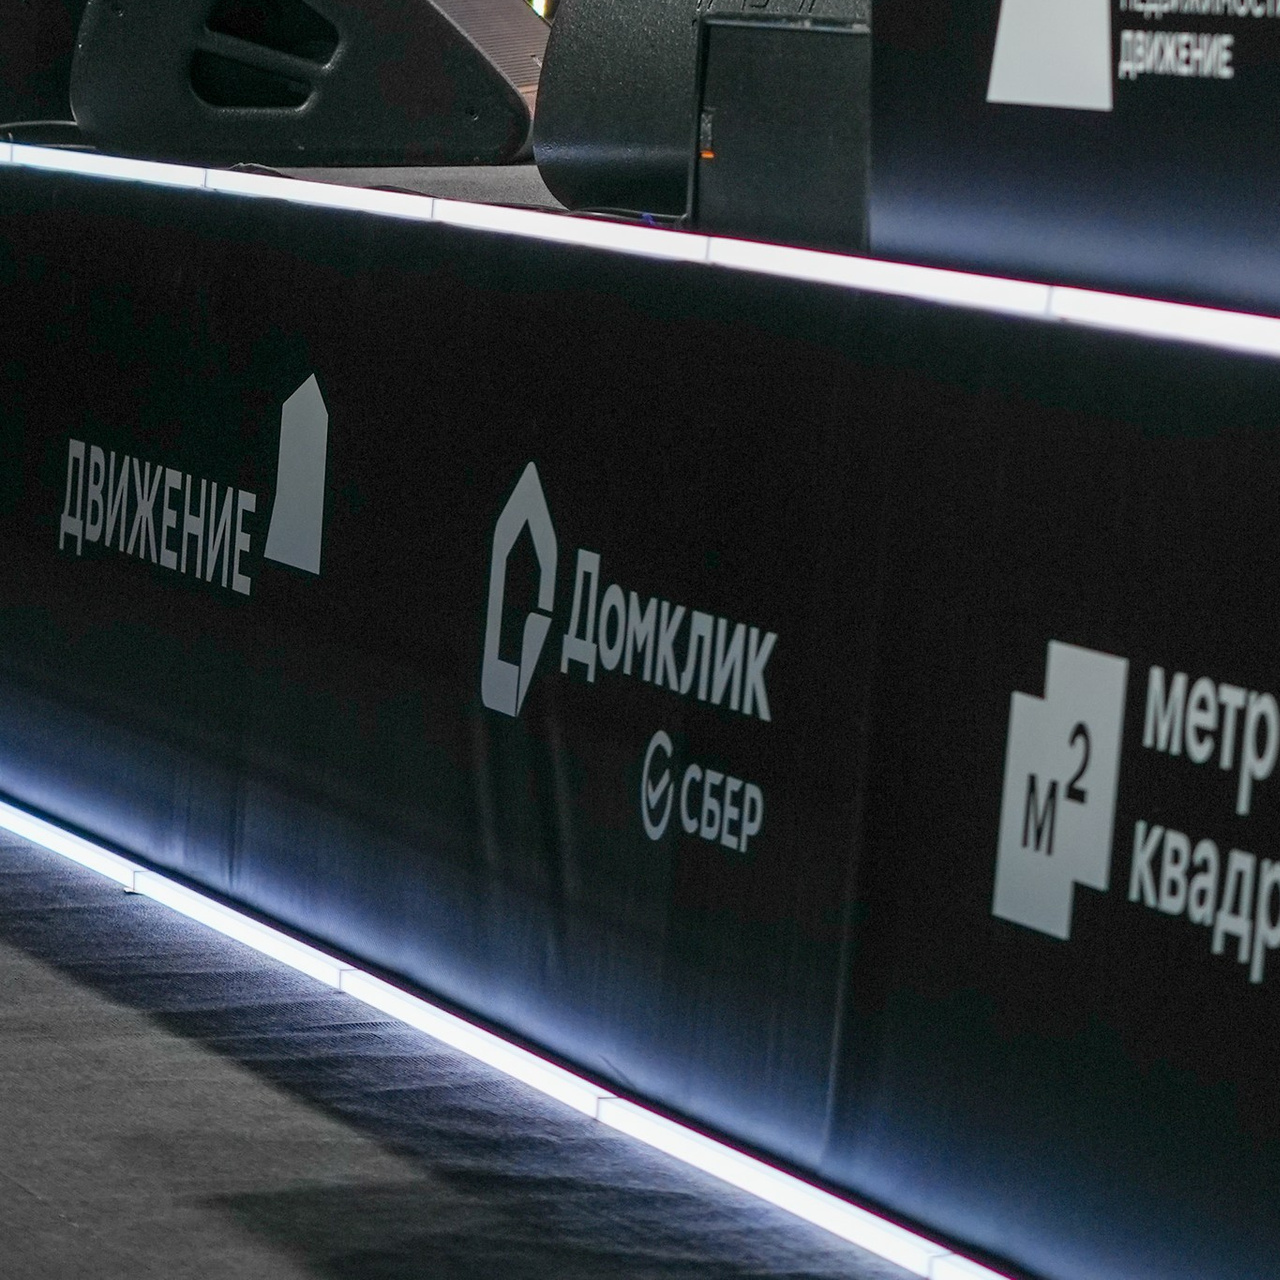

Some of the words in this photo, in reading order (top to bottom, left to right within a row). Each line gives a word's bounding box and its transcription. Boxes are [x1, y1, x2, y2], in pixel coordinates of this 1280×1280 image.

[1117, 28, 1235, 81] ДВИЖЕНИЕ
[58, 437, 258, 597] ДВИЖЕНИЕ
[678, 762, 765, 855] СБЕР
